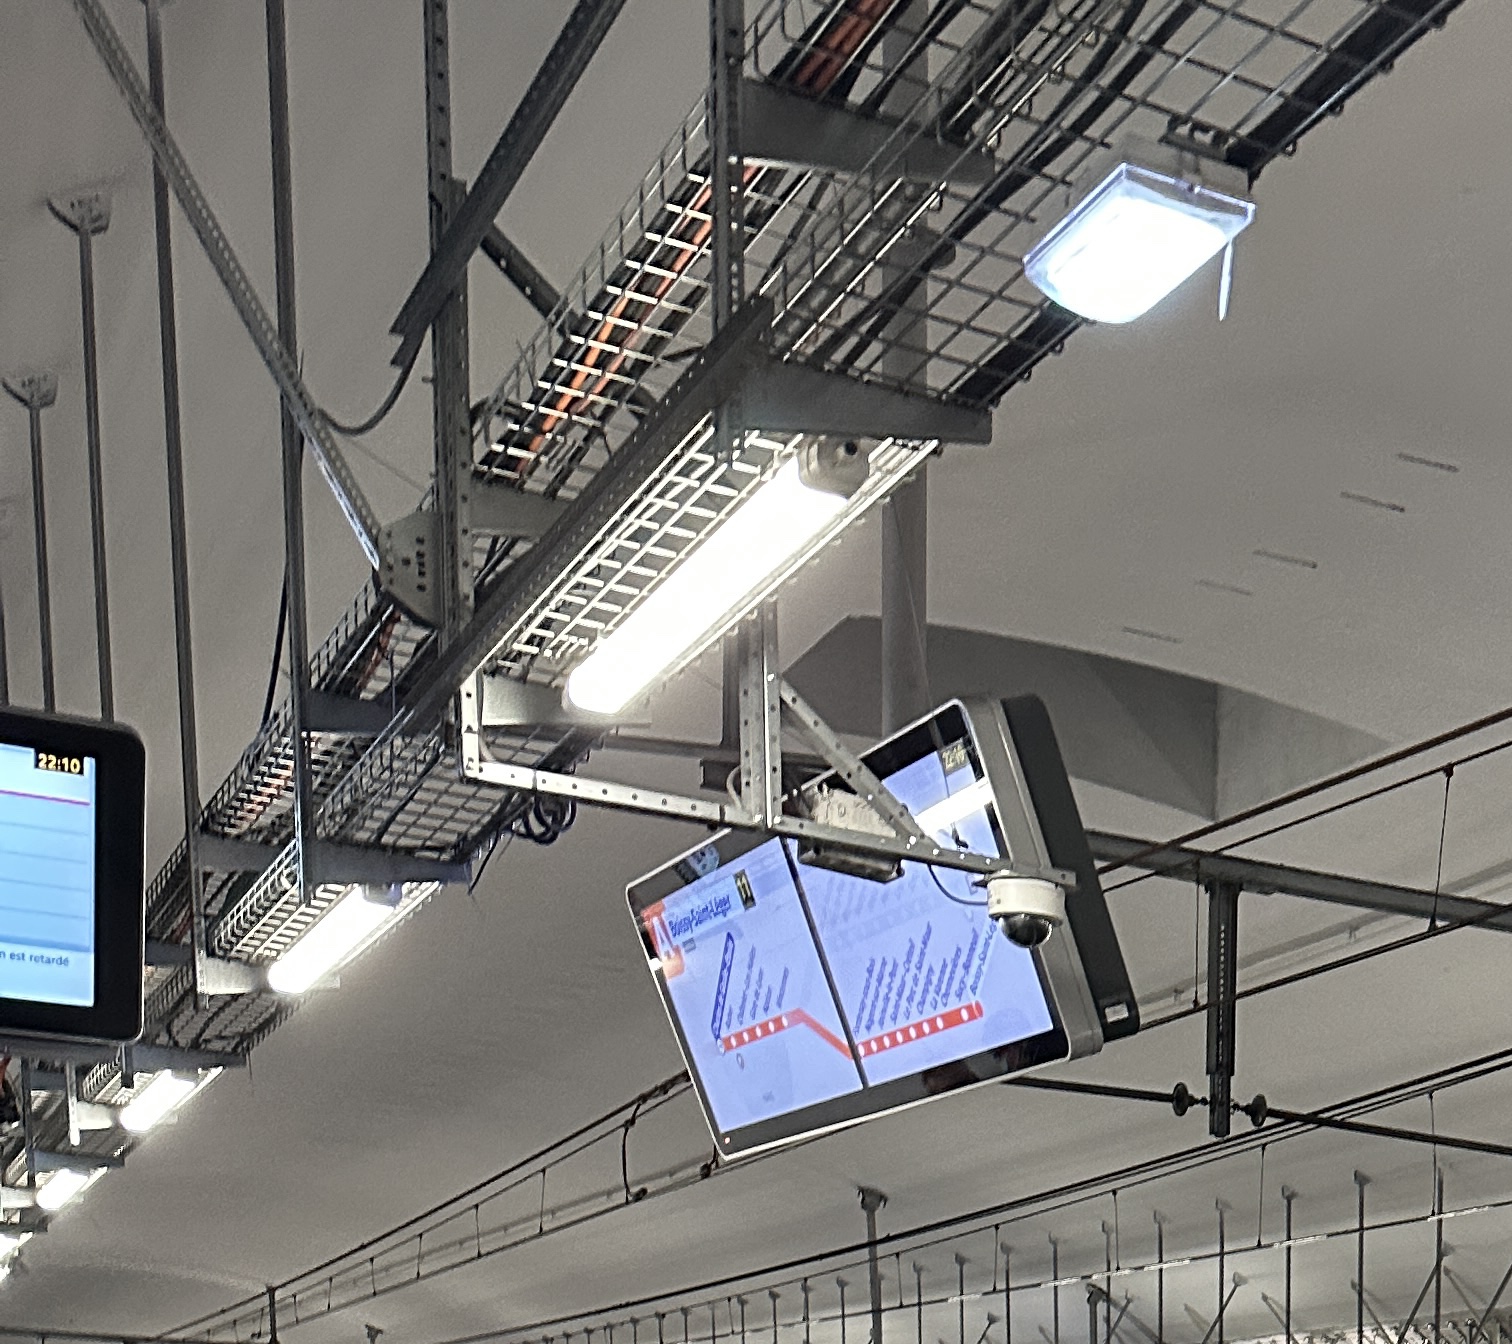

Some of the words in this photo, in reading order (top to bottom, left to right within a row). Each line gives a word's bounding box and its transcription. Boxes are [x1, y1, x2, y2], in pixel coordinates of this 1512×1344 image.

[38, 752, 81, 774] 22:10
[9, 952, 26, 961] est
[29, 954, 69, 967] retardé
